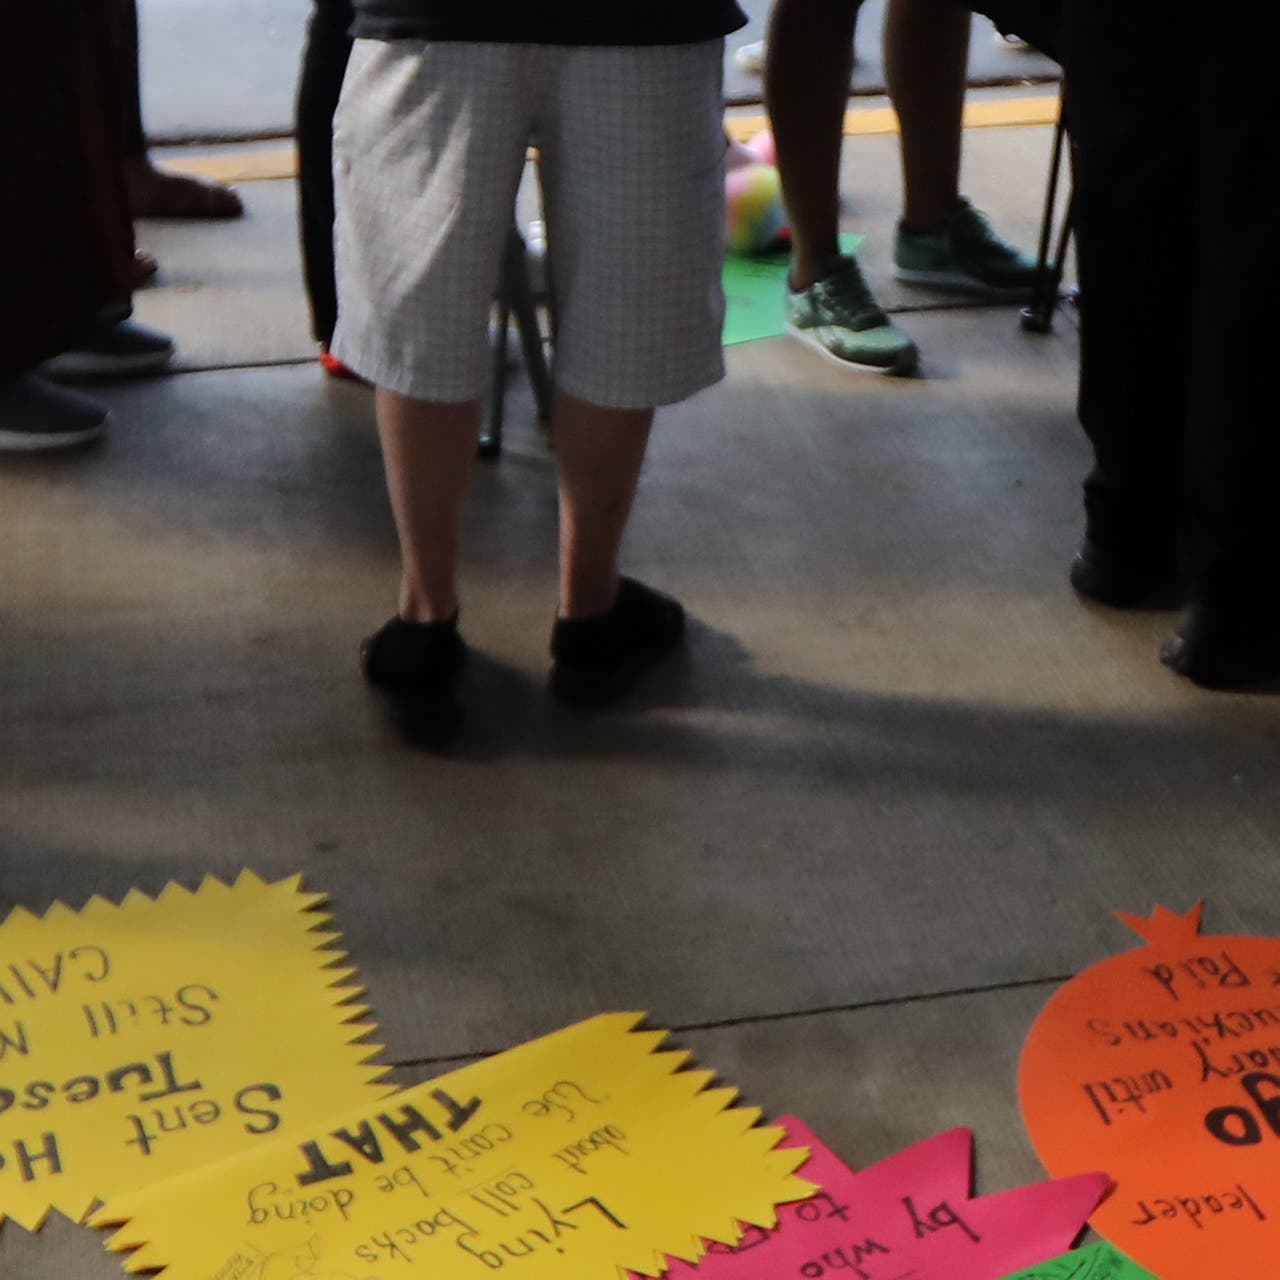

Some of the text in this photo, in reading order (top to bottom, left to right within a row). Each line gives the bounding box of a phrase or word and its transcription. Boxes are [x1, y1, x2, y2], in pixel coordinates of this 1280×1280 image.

[81, 982, 219, 1038] Still
[124, 1081, 283, 1157] Sent
[1082, 1069, 1174, 1126] until
[293, 1088, 483, 1187] THAT
[246, 1181, 355, 1226] doing
[374, 1165, 428, 1198] be
[468, 1171, 534, 1217] call
[794, 1190, 850, 1225] to
[901, 1196, 981, 1244] by
[1130, 1184, 1266, 1229] leader
[354, 1207, 480, 1265] backs
[455, 1196, 628, 1270] Lying
[800, 1237, 890, 1280] who
